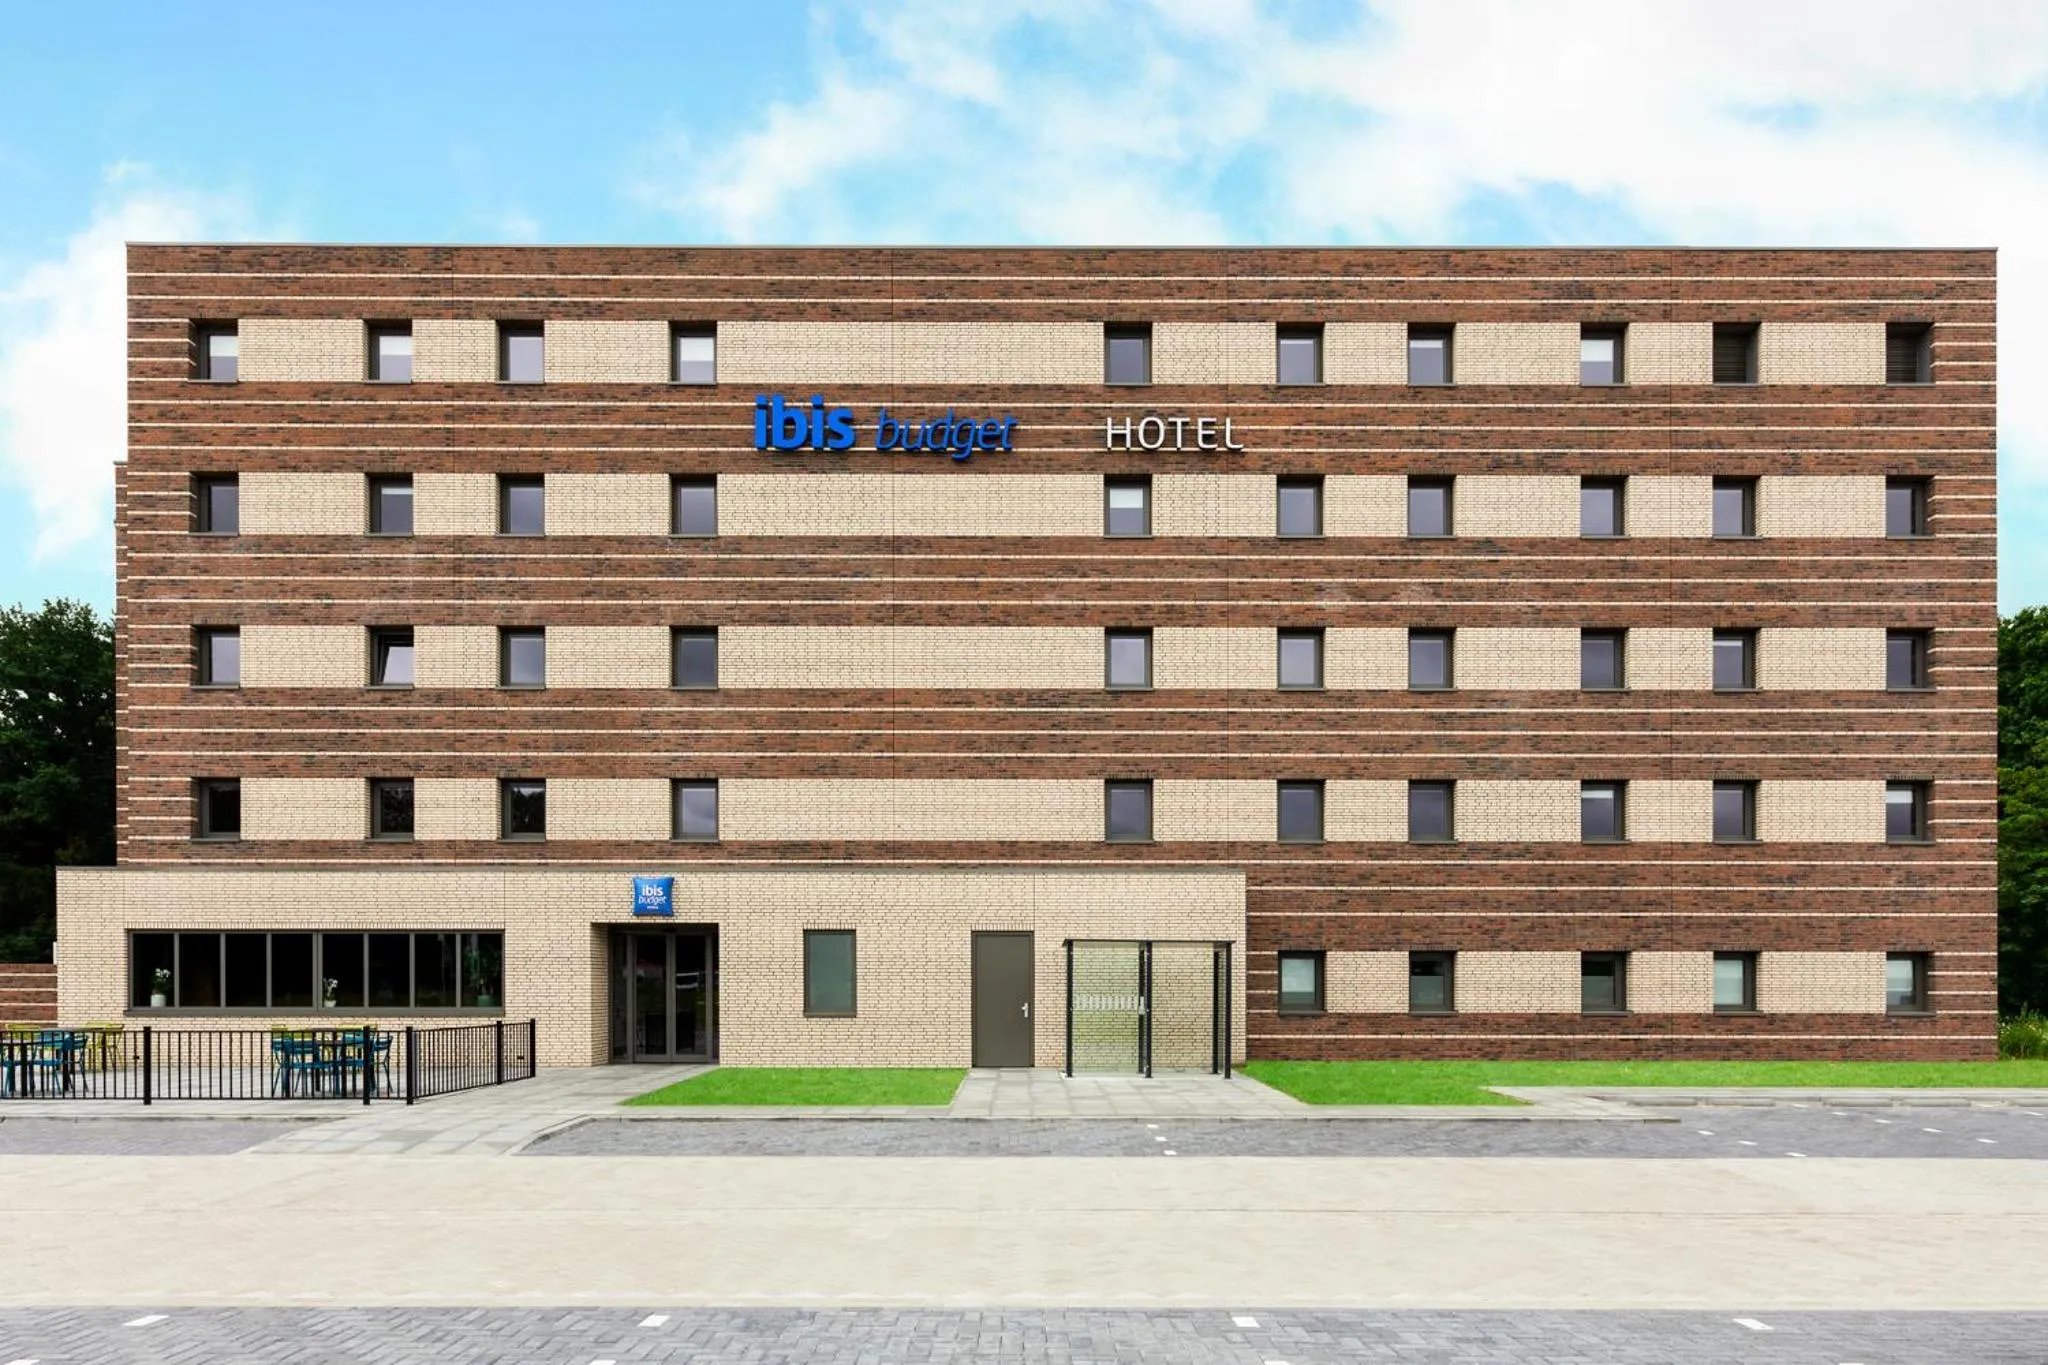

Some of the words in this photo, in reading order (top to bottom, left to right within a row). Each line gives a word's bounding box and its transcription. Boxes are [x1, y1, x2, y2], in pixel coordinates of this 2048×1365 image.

[754, 394, 856, 450] ibis
[875, 407, 1018, 460] budget
[1106, 416, 1244, 450] HOTEL
[642, 883, 664, 896] ibis
[638, 895, 667, 906] budget
